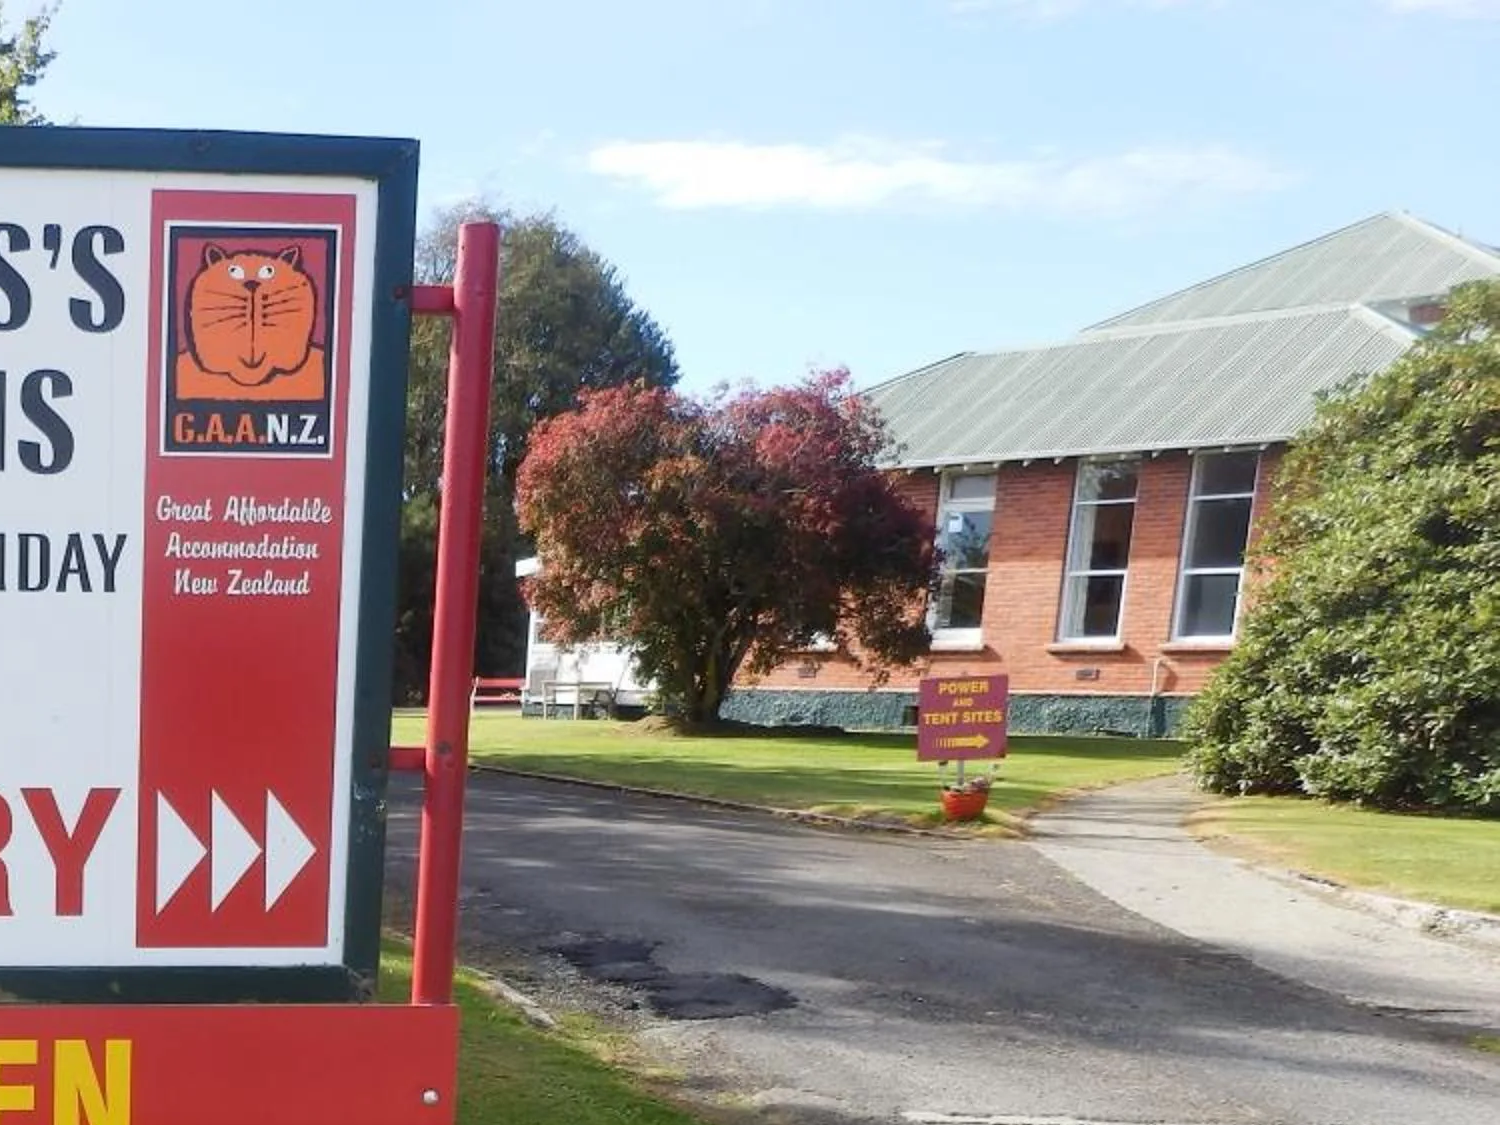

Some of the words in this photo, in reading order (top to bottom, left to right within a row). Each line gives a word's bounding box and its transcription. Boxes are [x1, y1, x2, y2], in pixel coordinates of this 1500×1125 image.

[156, 495, 213, 523] Great
[223, 496, 333, 526] Affordable
[165, 532, 319, 560] Accommodation
[174, 568, 218, 595] New
[227, 569, 311, 597] Zealand
[938, 680, 990, 695] POWER
[953, 697, 974, 707] AND
[924, 712, 959, 725] TENT
[963, 710, 1003, 723] SITES
